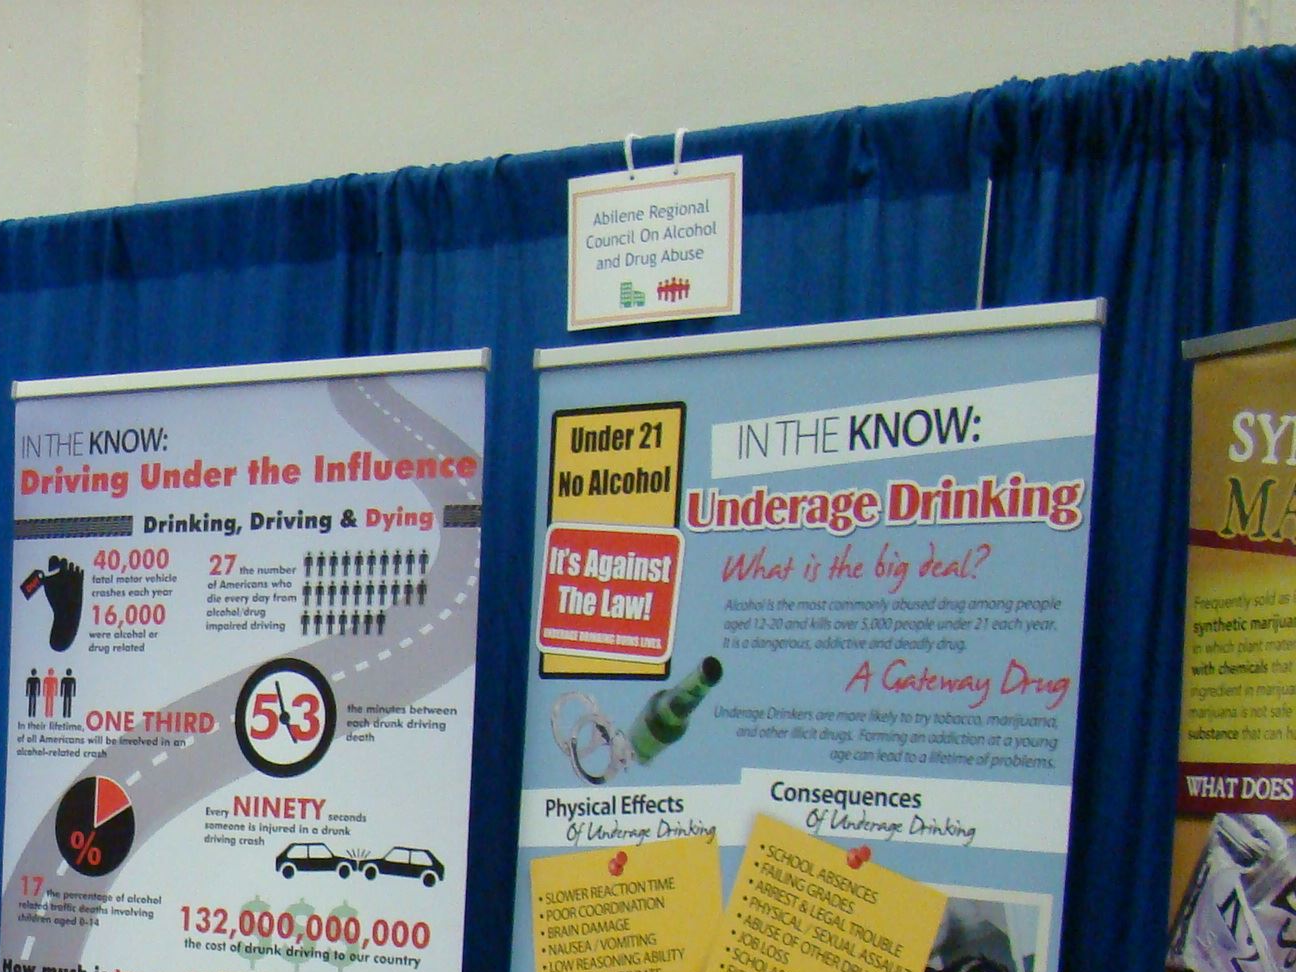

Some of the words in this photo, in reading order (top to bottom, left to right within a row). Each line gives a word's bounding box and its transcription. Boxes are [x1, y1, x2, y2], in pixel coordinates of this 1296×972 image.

[593, 206, 645, 226] Abilene
[649, 200, 710, 222] Regional
[586, 229, 634, 249] Council
[640, 227, 659, 243] On
[663, 221, 717, 240] Alcohol
[596, 254, 620, 270] and
[625, 251, 657, 272] Drug
[661, 246, 704, 263] Abuse
[22, 435, 40, 458] IN
[44, 432, 84, 457] THE
[89, 428, 168, 454] KNOW:
[571, 425, 626, 453] Under
[637, 422, 662, 449] 21
[738, 425, 769, 459] IN
[776, 418, 839, 454] THE
[849, 406, 980, 451] KNOW:
[20, 465, 128, 498] Driving
[141, 460, 237, 489] Under
[248, 455, 301, 486] the
[314, 452, 477, 483] Influence
[559, 472, 584, 497] No
[588, 468, 671, 496] Alcohol
[687, 490, 878, 532] Underage
[887, 475, 1081, 525] Drinking
[144, 512, 243, 535] Drinking,
[250, 508, 331, 535] Driving
[340, 510, 359, 528] &
[366, 508, 434, 531] Dying
[93, 549, 169, 572] 40,000
[210, 554, 237, 575] 27
[550, 547, 581, 576] It's
[584, 547, 672, 583] Against
[722, 544, 792, 582] What
[804, 546, 818, 580] is
[829, 544, 863, 580] the
[875, 543, 910, 593] big
[919, 543, 993, 580] deal?
[92, 605, 165, 628] 16,000
[558, 586, 596, 616] The
[600, 590, 651, 621] Law!
[845, 660, 871, 693] A
[882, 660, 990, 699] Gateway
[1001, 659, 1070, 699] Drug
[86, 711, 134, 732] ONE
[143, 712, 215, 734] THIRD
[770, 781, 922, 809] Consequences
[1186, 774, 1238, 798] WHAT
[1241, 776, 1294, 800] DOES
[233, 796, 327, 819] NINETY
[546, 796, 616, 821] Physical
[621, 795, 684, 814] Effects
[567, 822, 585, 846] Of
[587, 820, 651, 846] Underage
[657, 819, 716, 844] Drinking
[807, 809, 828, 834] Of
[830, 810, 903, 841] Underage
[909, 815, 976, 845] Drinking
[21, 876, 44, 896] 17
[766, 846, 815, 877] SCHOOL
[817, 868, 879, 905] ABSENCES
[546, 888, 588, 904] SLOWER
[590, 881, 647, 900] REACTION
[648, 877, 675, 891] TIME
[181, 906, 431, 950] 132,000,000,000
[548, 926, 580, 939] BRAIN
[582, 918, 630, 935] DAMAGE
[184, 938, 203, 950] the
[205, 941, 228, 951] cost
[231, 941, 242, 953] of
[244, 943, 282, 956] drunk
[285, 946, 330, 963] driving
[334, 950, 345, 961] to
[348, 952, 370, 963] our
[373, 953, 421, 969] country
